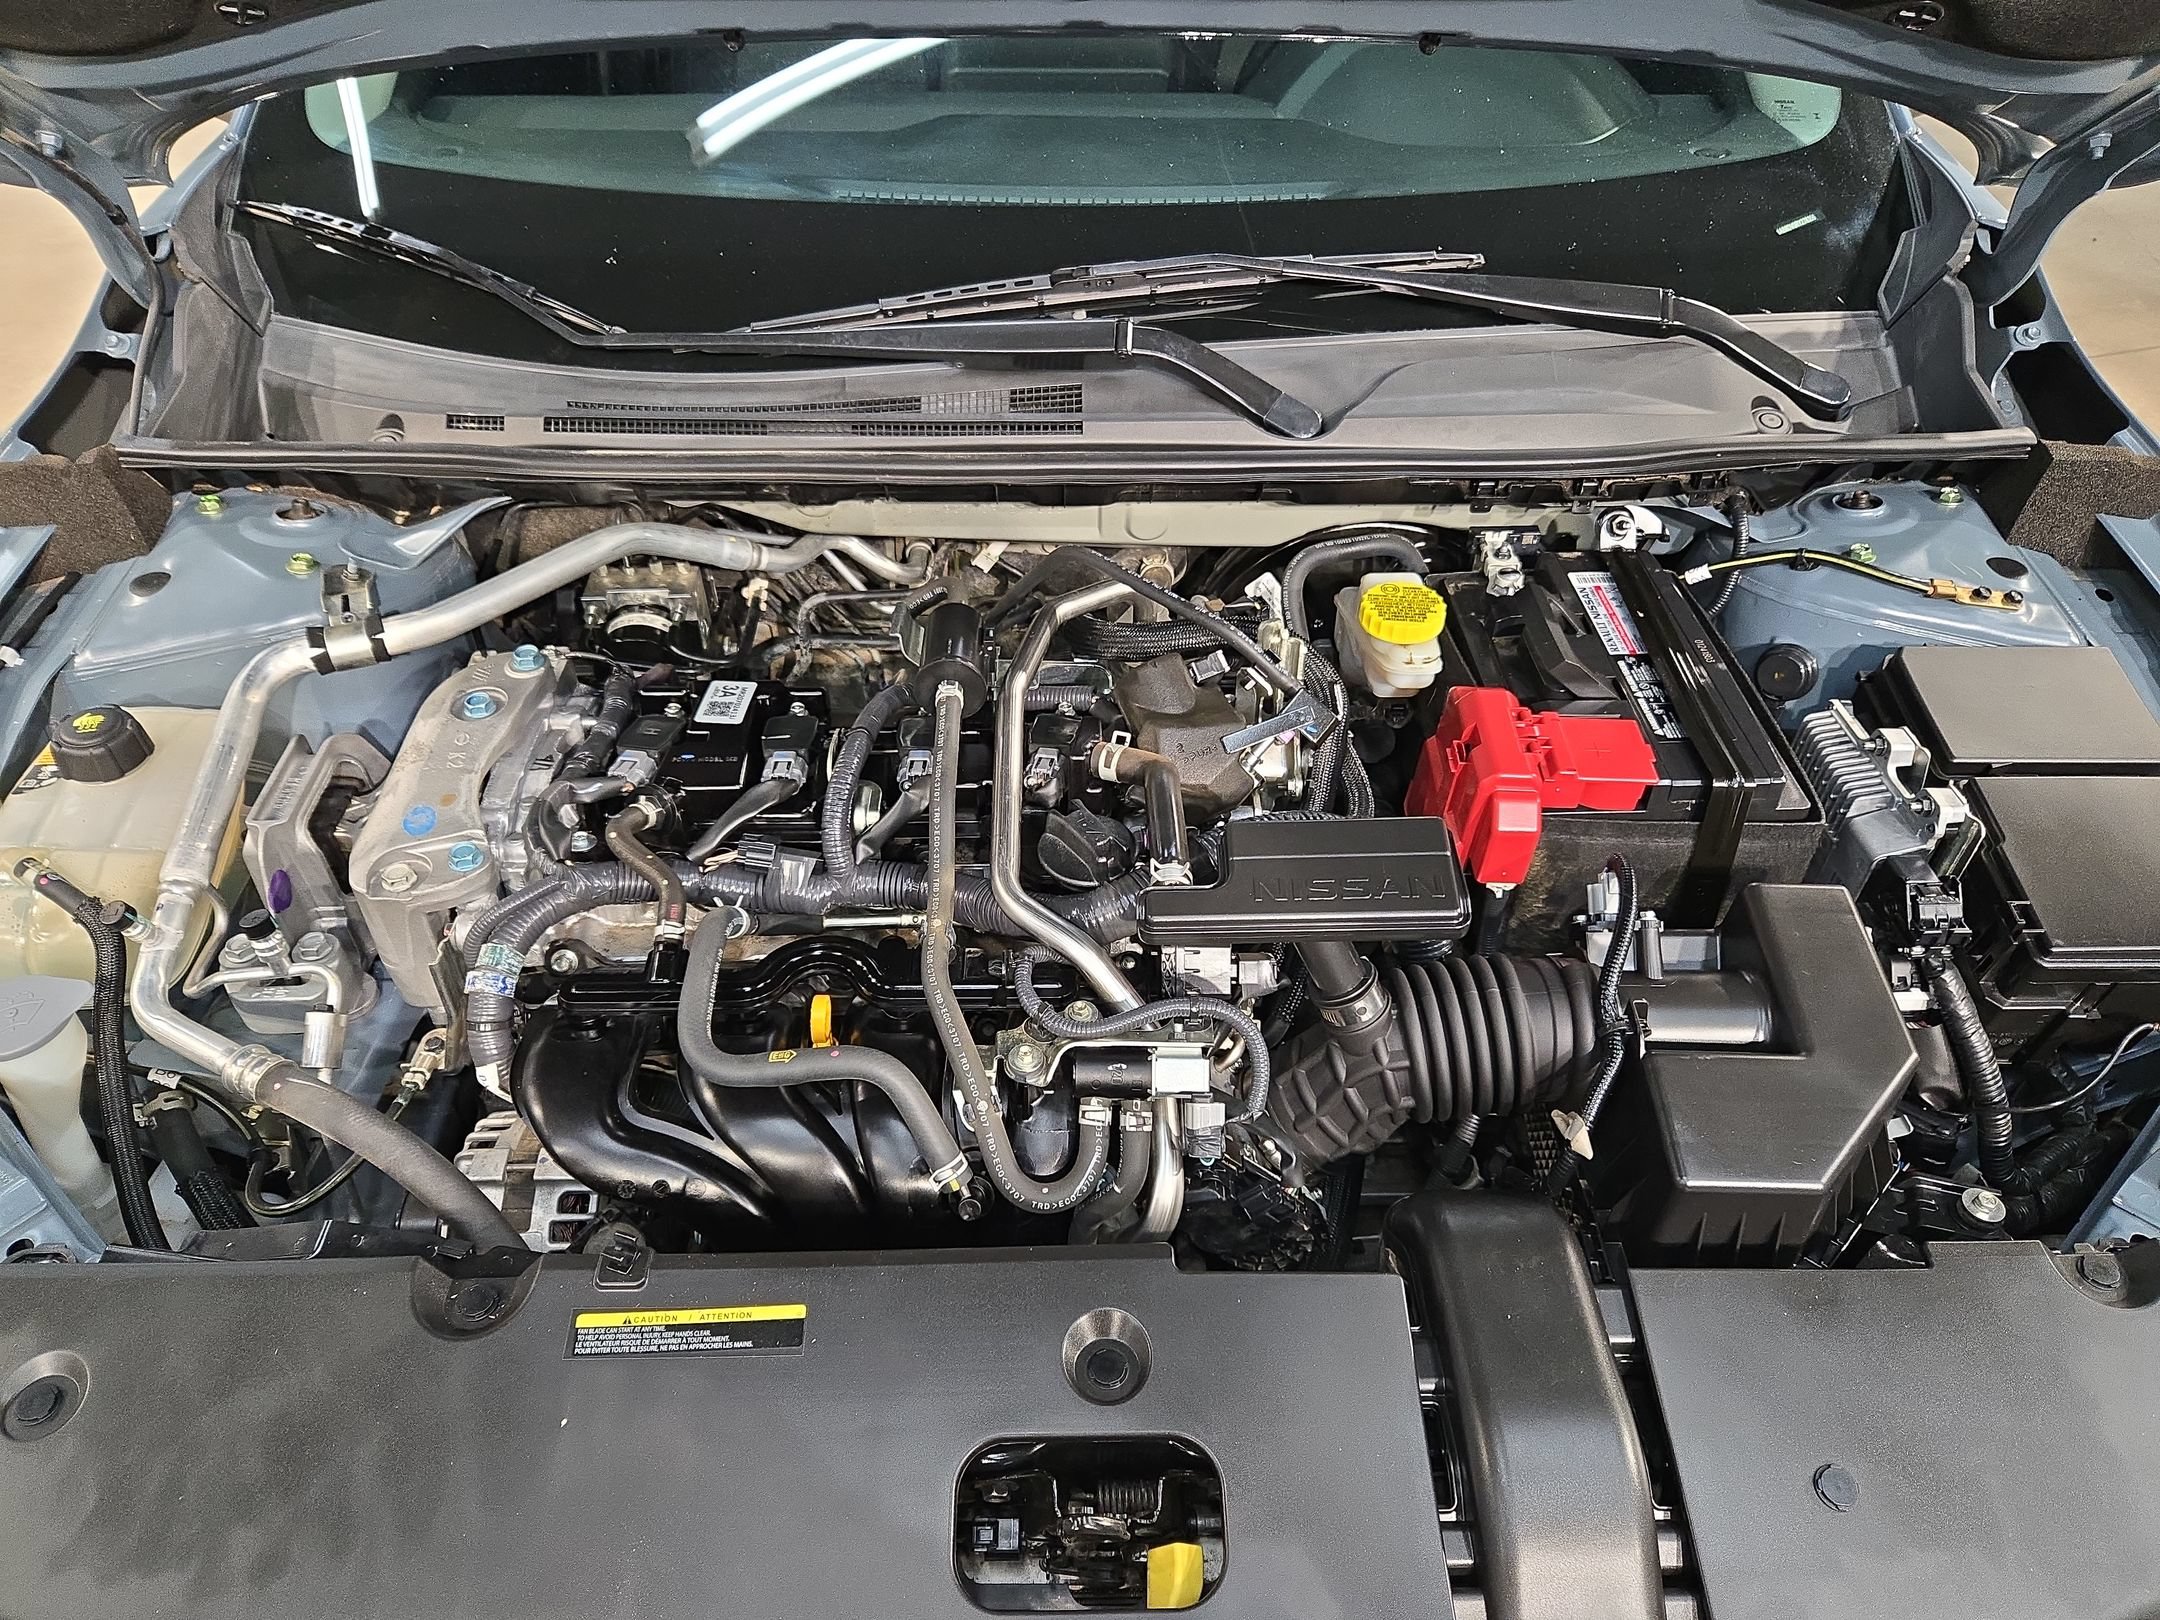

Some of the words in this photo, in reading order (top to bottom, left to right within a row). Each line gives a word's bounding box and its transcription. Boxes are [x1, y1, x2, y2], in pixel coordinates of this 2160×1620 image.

[1578, 587, 1600, 621] NISSAN
[718, 685, 740, 698] 3A
[933, 806, 941, 873] TRD>ECO<3707
[1253, 875, 1446, 902] NISSAN
[933, 989, 962, 1048] TRD>ECO<3707
[985, 1131, 1025, 1203] TRD>ECO<3707
[1031, 1169, 1098, 1211] TRD>ECO<3707
[633, 1315, 678, 1324] CAUTION
[699, 1311, 752, 1320] ATTENTION
[591, 1345, 610, 1353] ÉVITER
[611, 1345, 630, 1353] TOUTE
[630, 1344, 659, 1353] BLESSURE,
[688, 1342, 723, 1350] APPROCHER
[733, 1340, 753, 1348] MAINS.
[615, 1332, 642, 1340] PERSONAL
[650, 1336, 681, 1344] DÉMARRER
